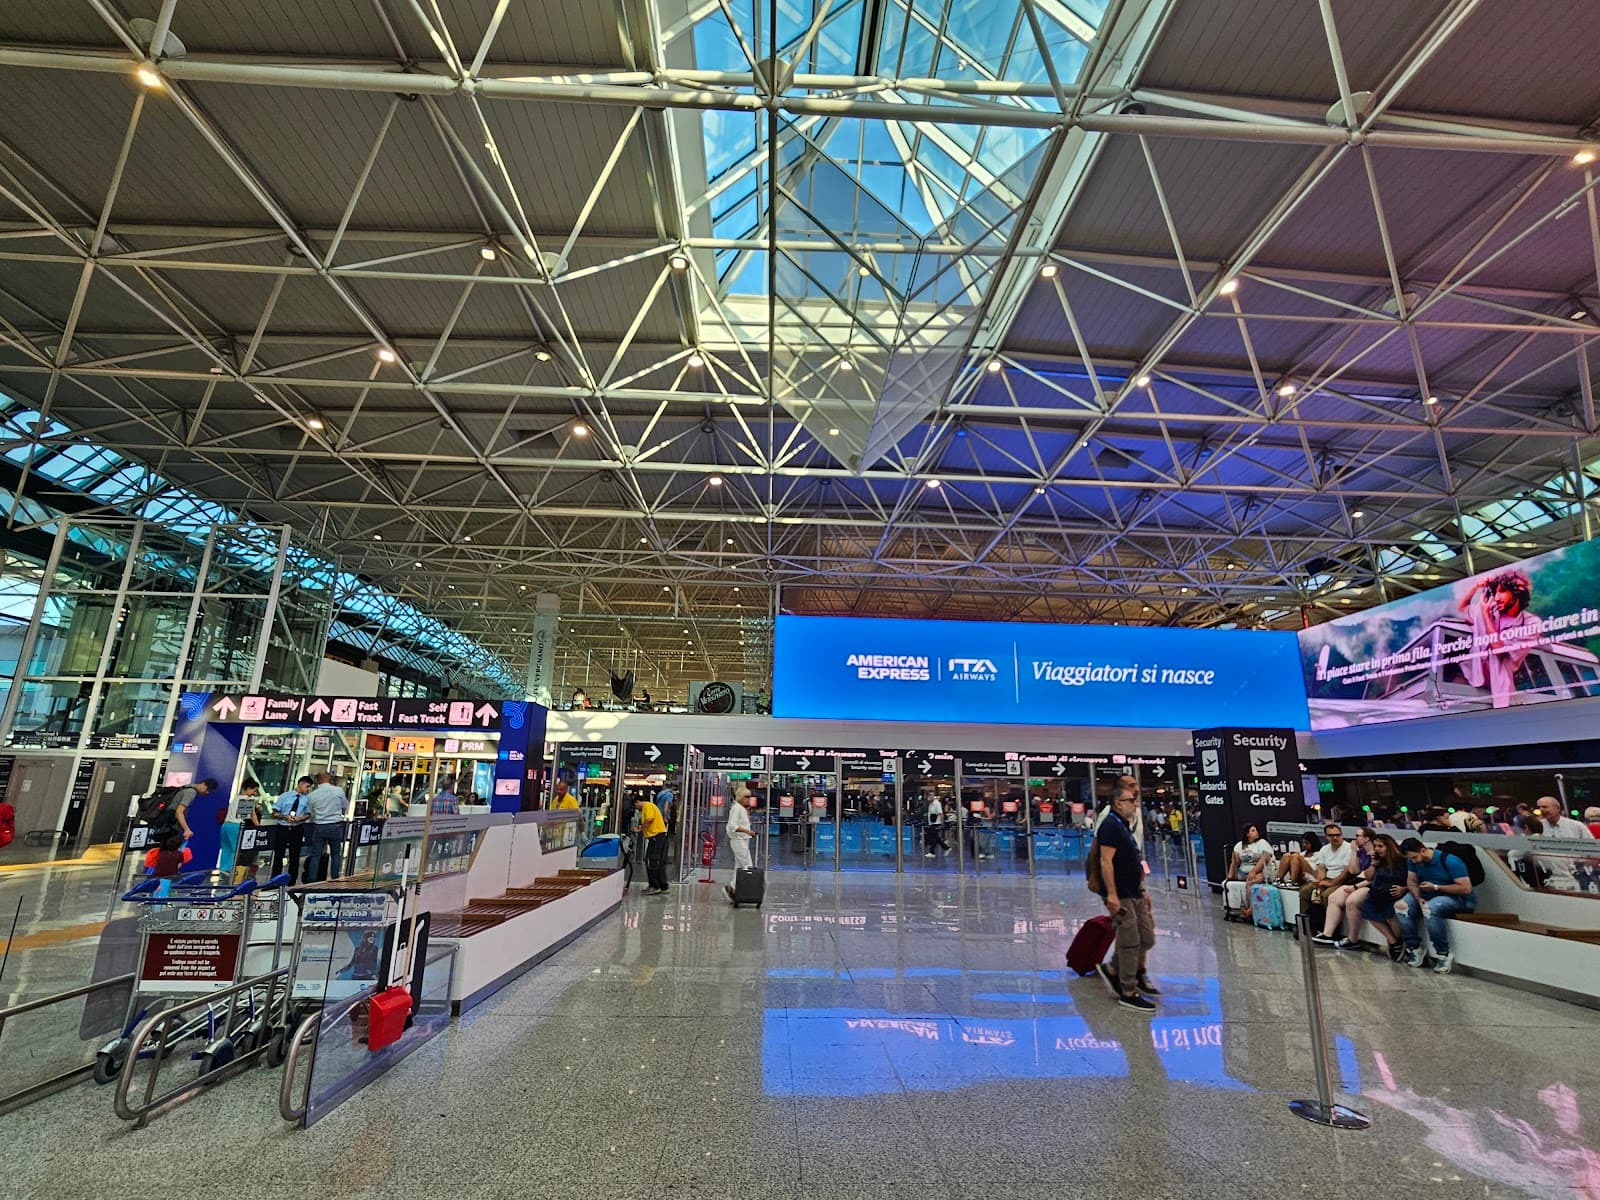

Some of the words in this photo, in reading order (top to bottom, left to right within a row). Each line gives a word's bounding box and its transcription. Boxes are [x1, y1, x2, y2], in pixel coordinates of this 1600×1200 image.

[1327, 666, 1348, 681] piace
[1349, 662, 1371, 673] stare
[1372, 658, 1380, 668] in
[1382, 652, 1411, 670] prima
[1434, 634, 1472, 654] Perché
[1474, 632, 1498, 645] non
[1500, 615, 1579, 640] cominciare
[1581, 608, 1599, 624] in
[846, 654, 928, 668] AMERICAN
[948, 658, 998, 673] ITA
[858, 667, 930, 680] EXPRESS
[952, 673, 996, 681] AIRWAYS
[1032, 661, 1138, 686] Viaggiatori
[1141, 664, 1158, 683] si
[1161, 668, 1214, 685] nasce
[267, 698, 299, 710] Family
[359, 701, 378, 711] Fast
[429, 703, 448, 713] Self
[265, 711, 288, 720] Lane
[357, 713, 383, 722] Track
[399, 714, 418, 724] Fast
[420, 714, 446, 724] Track
[462, 742, 484, 750] PRM
[1195, 737, 1221, 748] Security
[1233, 734, 1287, 750] Security
[1200, 781, 1227, 790] Imbarchi
[1238, 780, 1294, 792] Imbarchi
[1205, 795, 1224, 805] Gates
[1250, 794, 1286, 806] Gates
